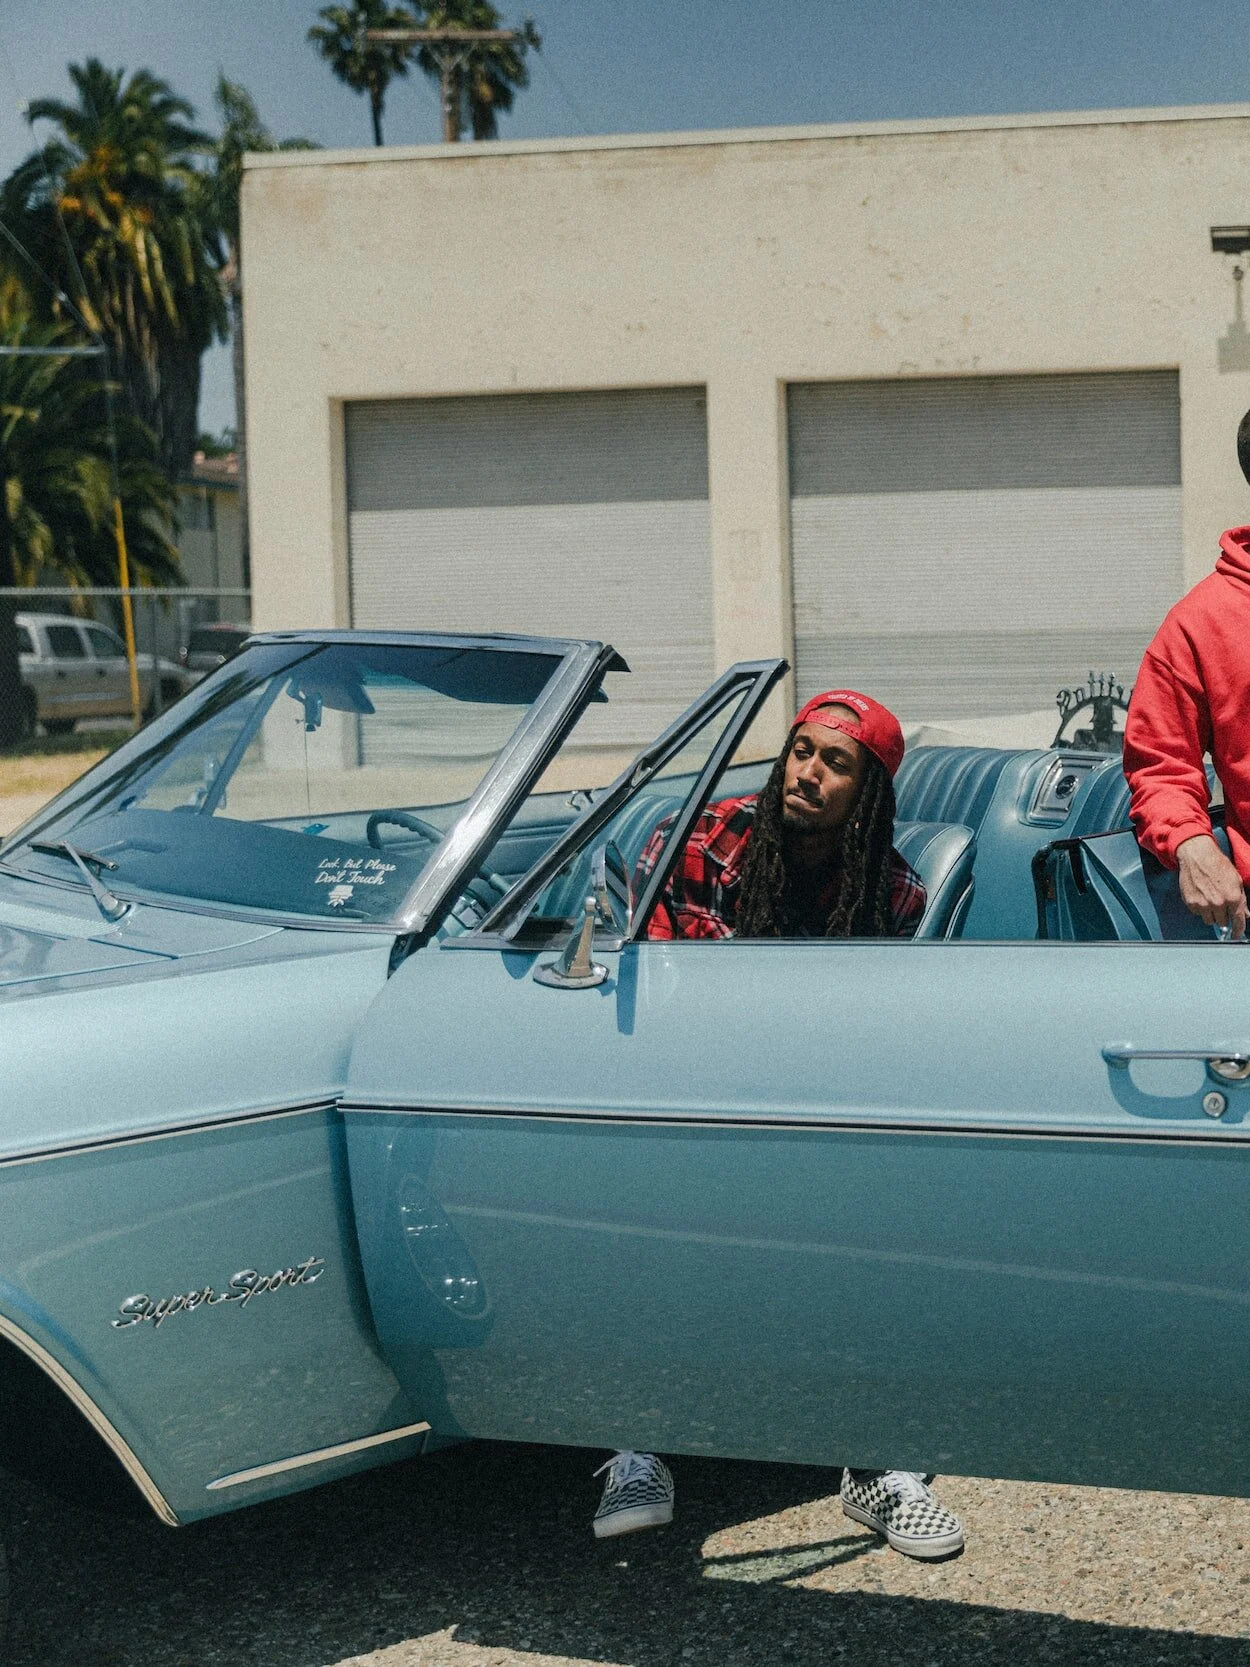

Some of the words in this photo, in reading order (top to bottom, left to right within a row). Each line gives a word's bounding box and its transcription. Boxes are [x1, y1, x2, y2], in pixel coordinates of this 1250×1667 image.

[343, 858, 363, 869] But
[365, 859, 397, 872] Please
[315, 870, 346, 884] Don't
[346, 870, 386, 885] Touch
[111, 1286, 222, 1329] Super
[221, 1256, 325, 1308] Sport
